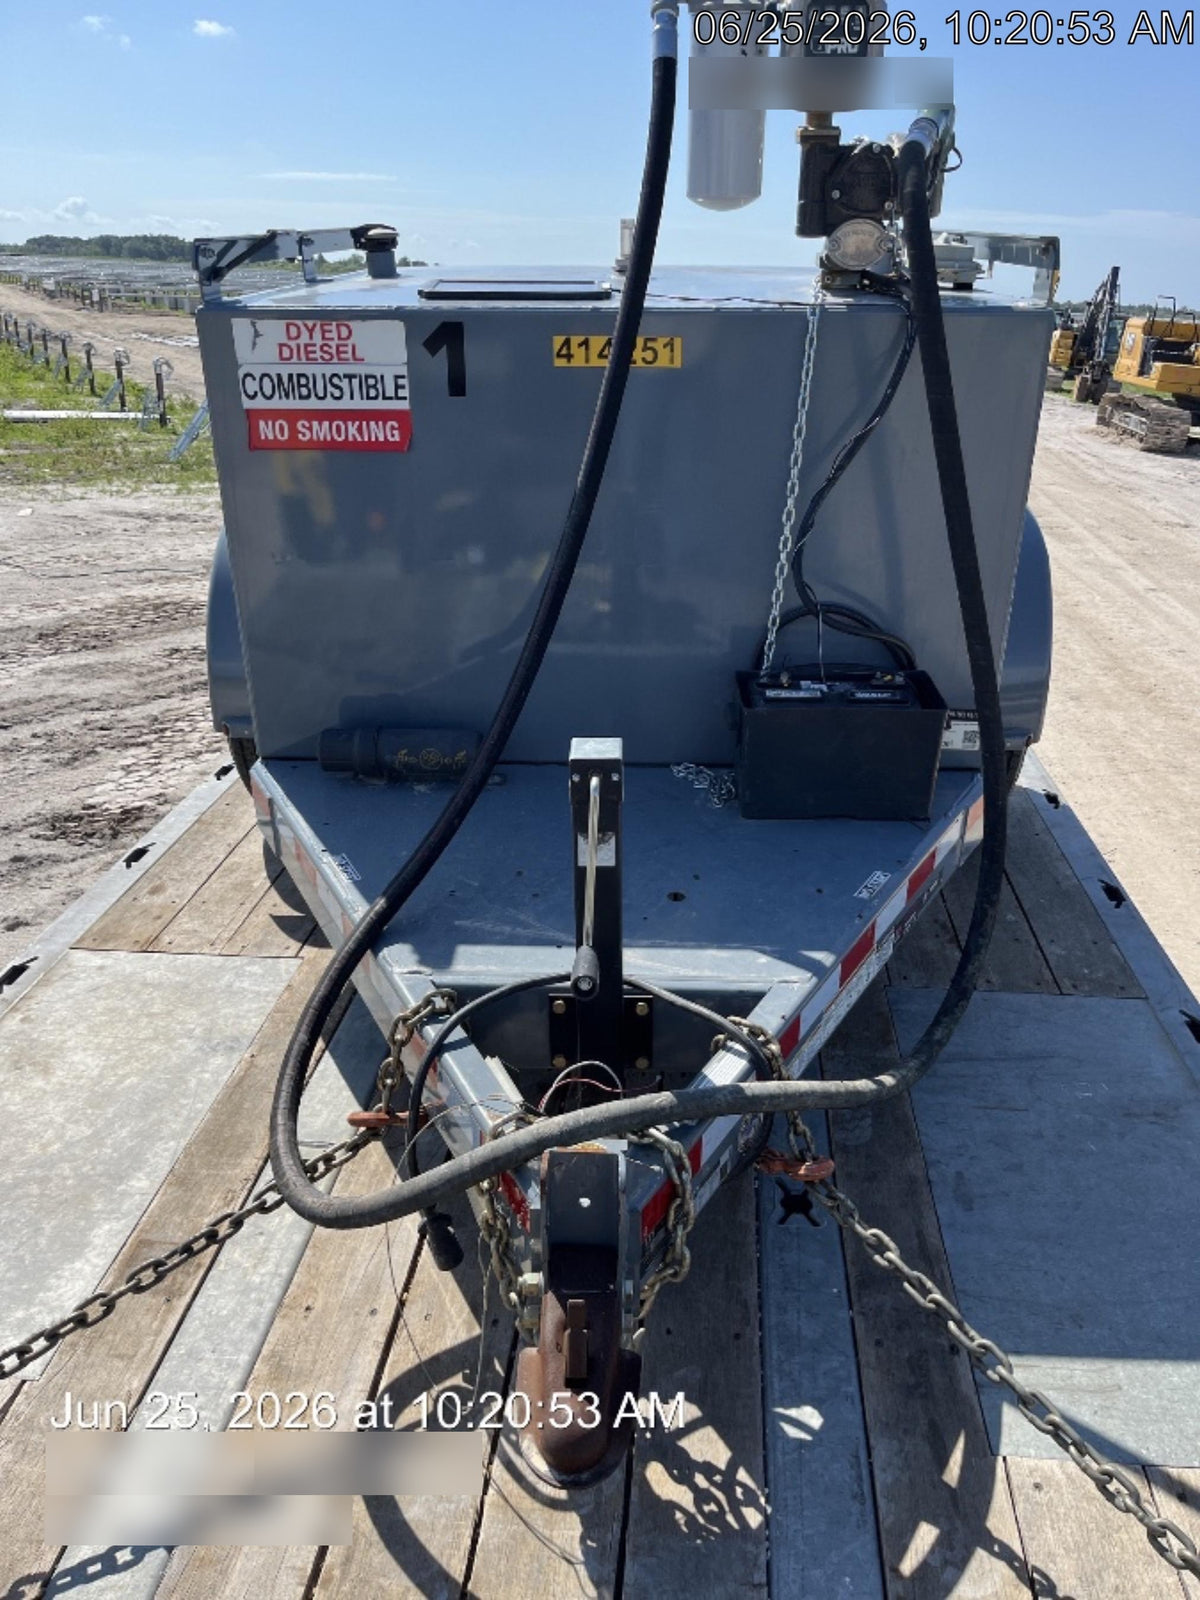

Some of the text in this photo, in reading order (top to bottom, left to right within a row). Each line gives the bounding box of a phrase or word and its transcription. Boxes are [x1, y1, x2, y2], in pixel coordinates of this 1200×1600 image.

[285, 321, 352, 341] DYED
[278, 343, 365, 362] DIESEL
[422, 321, 467, 397] 1
[556, 337, 675, 365] 41451
[241, 372, 408, 401] COMBUSTIBLE
[258, 419, 400, 442] NO SMOKING
